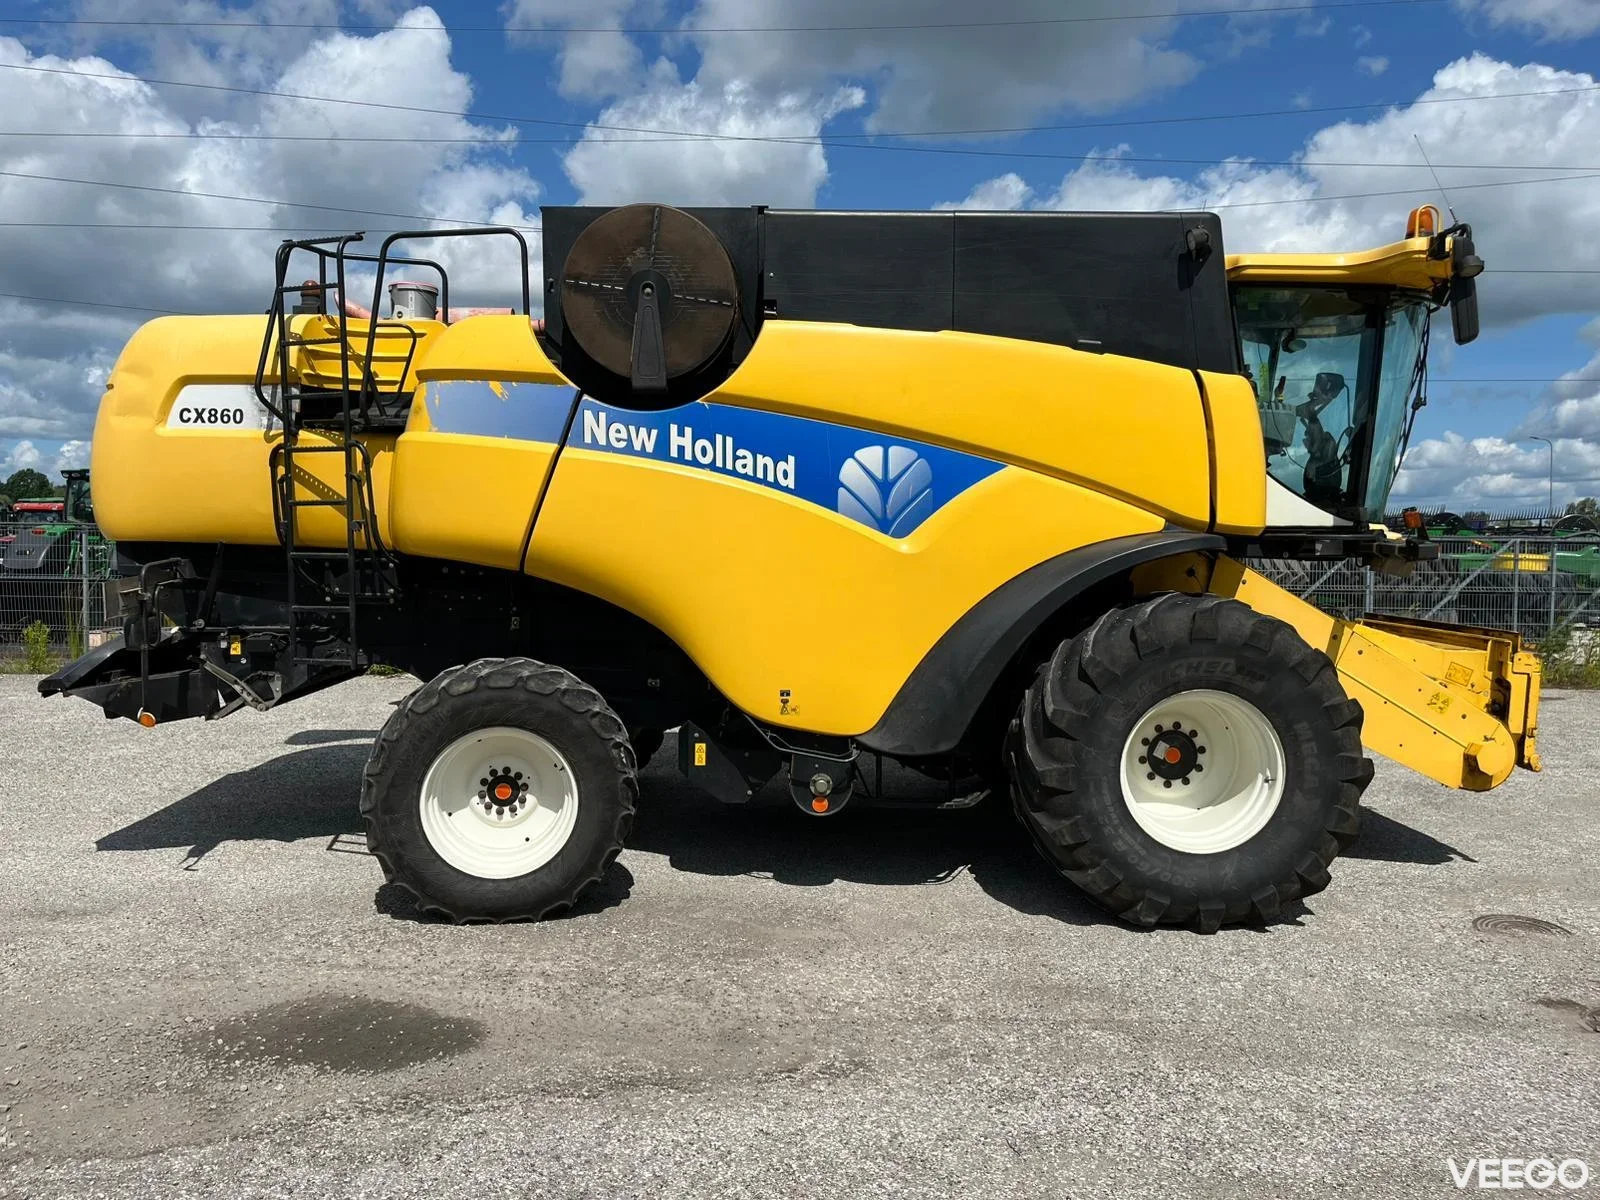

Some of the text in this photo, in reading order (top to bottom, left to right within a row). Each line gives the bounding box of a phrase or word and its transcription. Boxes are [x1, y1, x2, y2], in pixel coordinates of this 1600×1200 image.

[178, 407, 245, 425] CX860
[583, 409, 796, 490] New Holland
